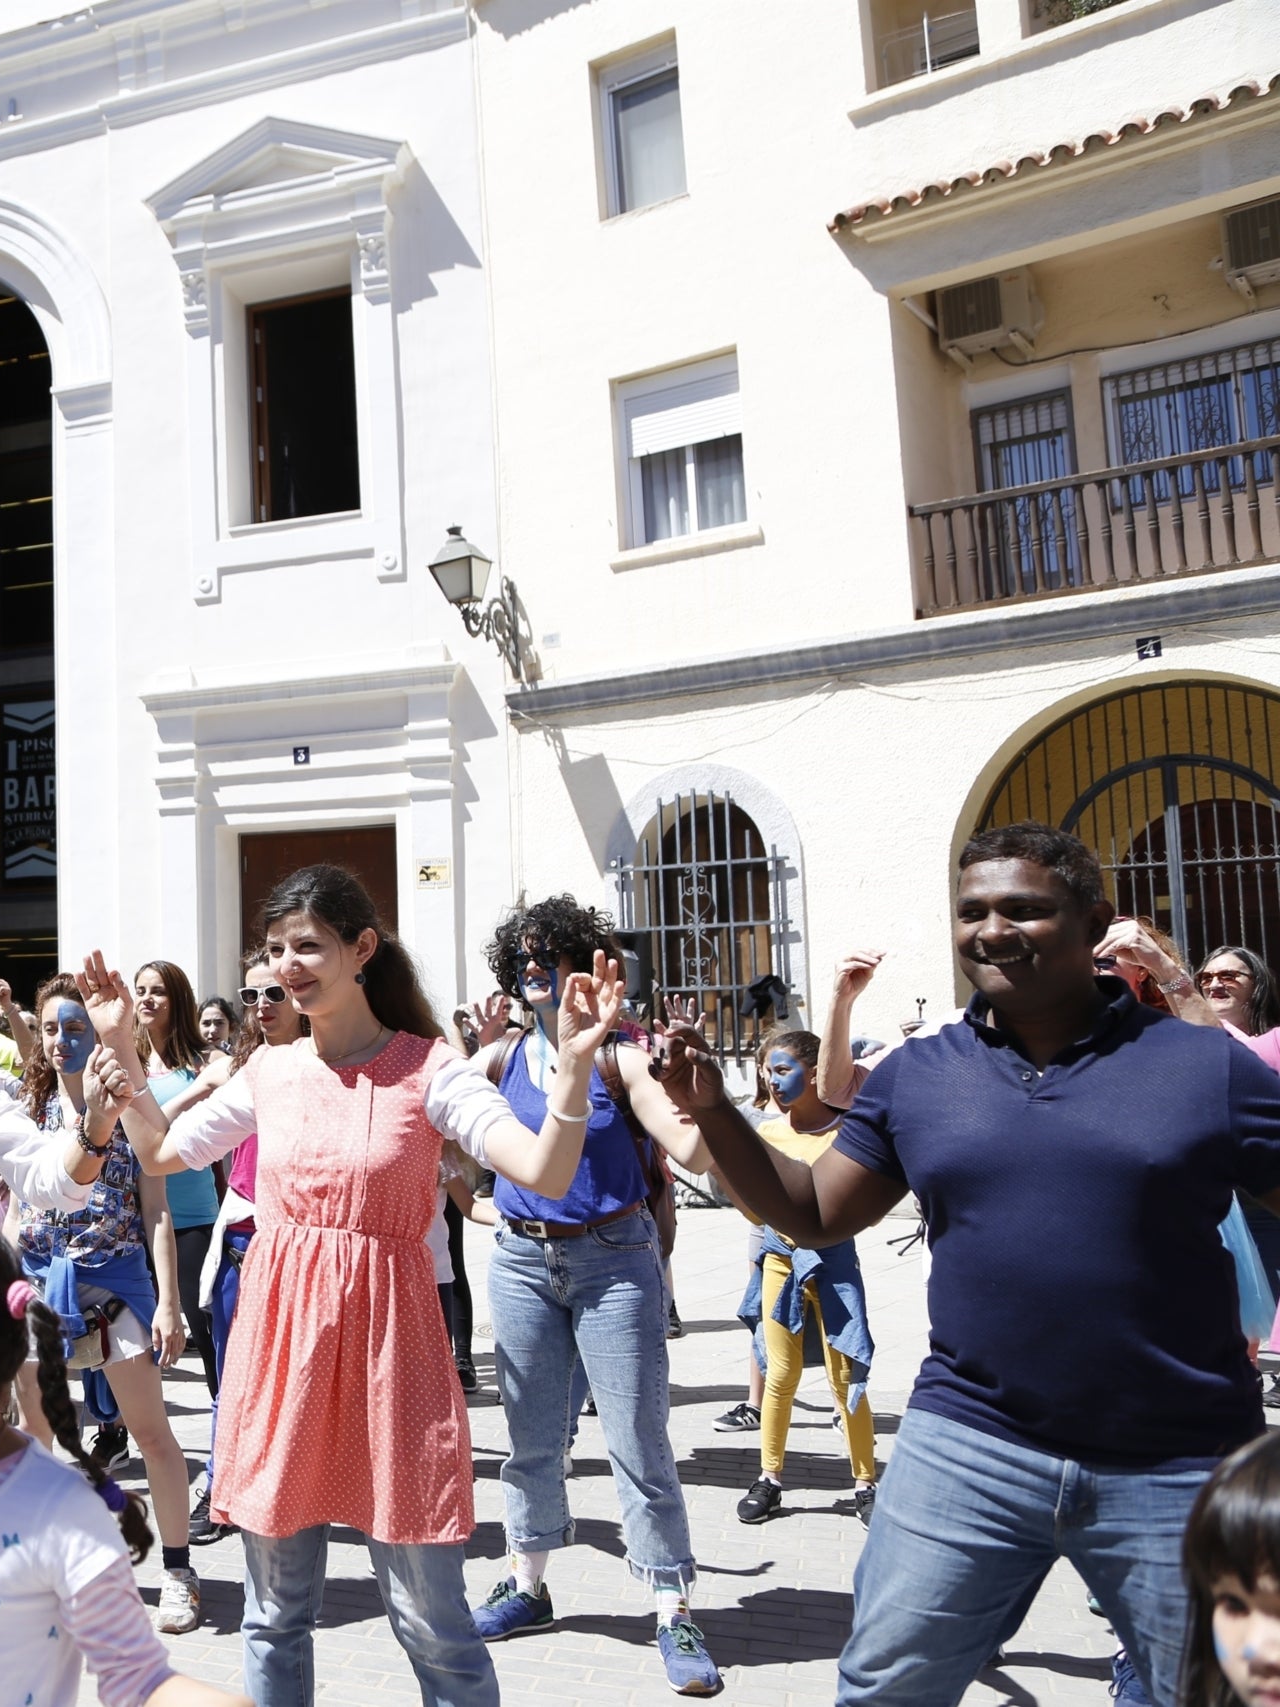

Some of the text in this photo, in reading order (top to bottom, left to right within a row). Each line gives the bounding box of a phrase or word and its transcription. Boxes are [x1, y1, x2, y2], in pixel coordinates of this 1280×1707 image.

[1142, 640, 1156, 656] 4
[297, 749, 306, 762] 3
[4, 775, 56, 809] BAR
